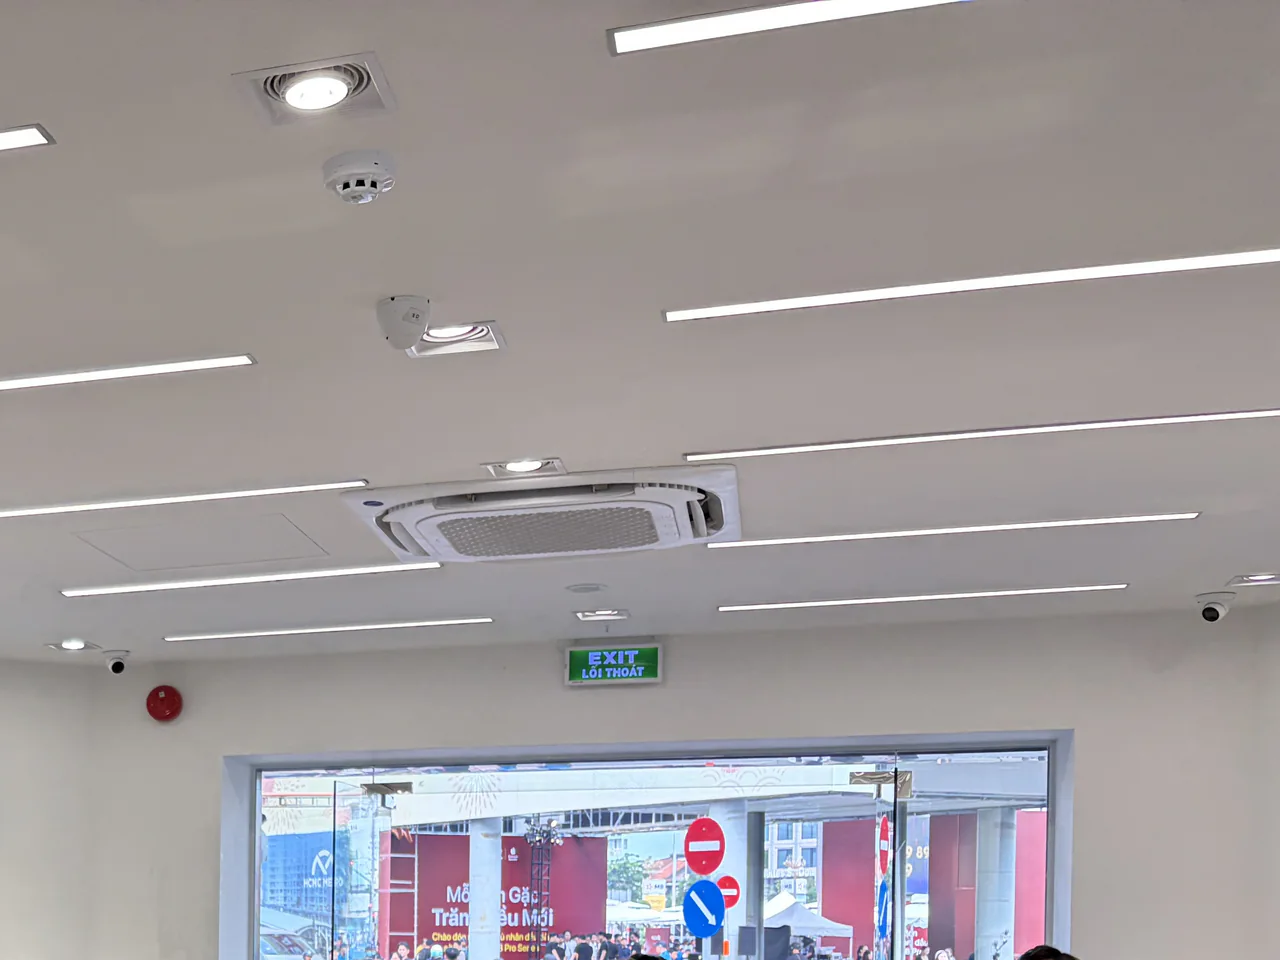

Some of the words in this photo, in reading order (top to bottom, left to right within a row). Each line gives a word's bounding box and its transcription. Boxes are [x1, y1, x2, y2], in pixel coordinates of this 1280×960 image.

[588, 650, 639, 665] EXIT
[581, 664, 603, 679] LỐI
[605, 664, 645, 678] THOÁT
[446, 883, 470, 904] Mỗ
